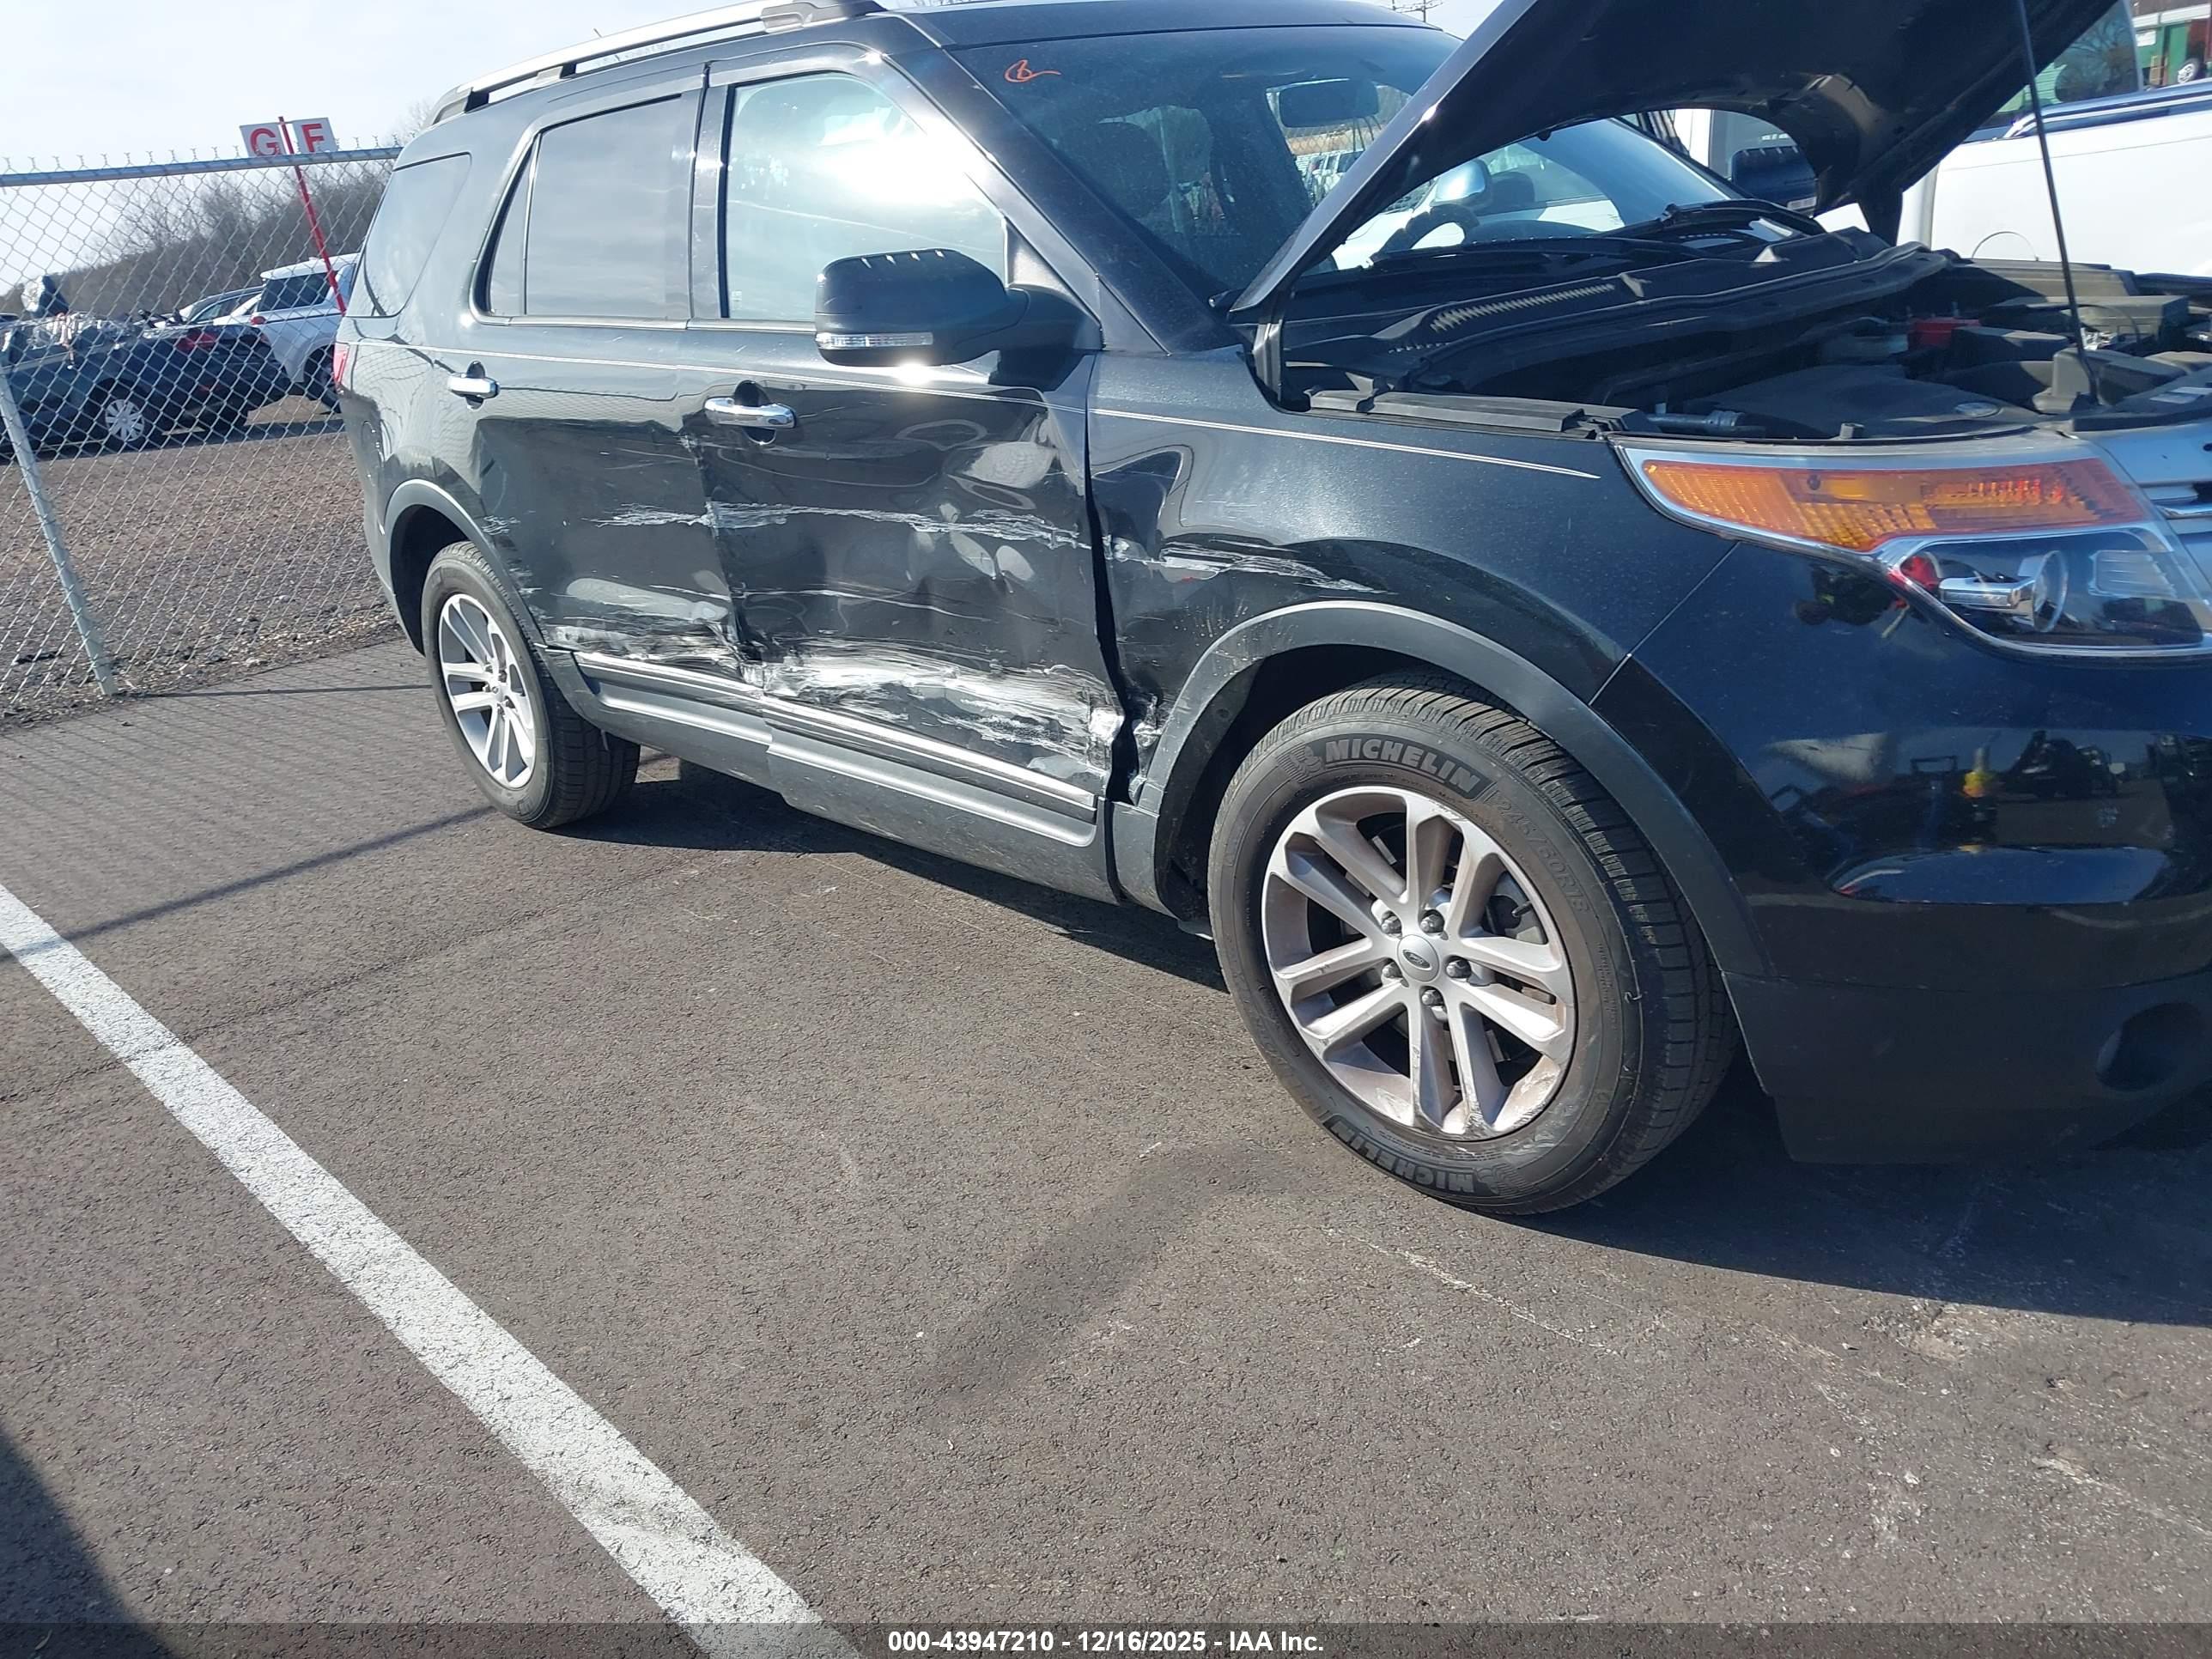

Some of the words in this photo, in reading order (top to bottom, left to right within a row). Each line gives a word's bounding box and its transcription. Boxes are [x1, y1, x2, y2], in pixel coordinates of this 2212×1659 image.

[250, 127, 281, 156] G
[301, 123, 325, 153] F
[1325, 738, 1480, 794] MICHELIN
[1330, 1120, 1475, 1194] MICHELIN
